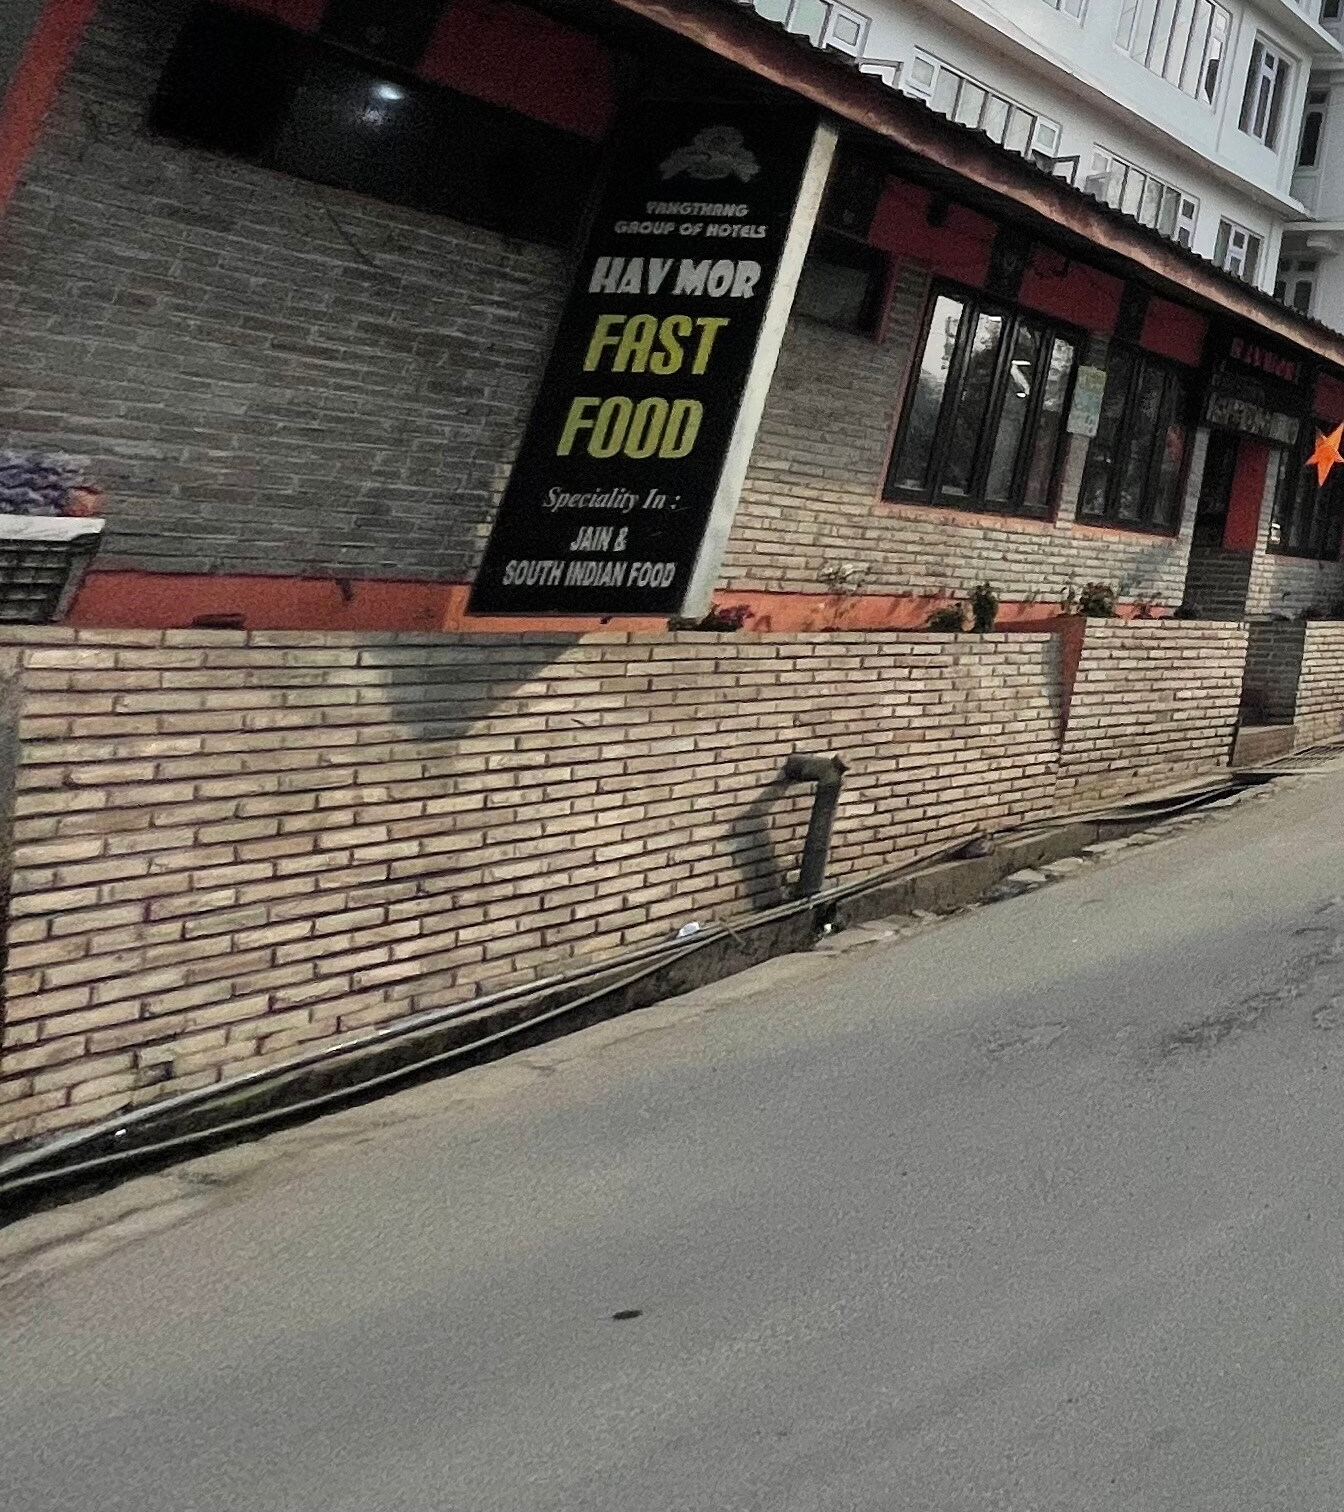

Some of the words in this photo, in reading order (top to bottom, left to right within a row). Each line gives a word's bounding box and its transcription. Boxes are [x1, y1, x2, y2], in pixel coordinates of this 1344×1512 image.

[614, 221, 676, 234] GROUP
[679, 223, 704, 236] OF
[706, 224, 766, 238] HOTELS
[583, 314, 731, 375] FAST
[557, 396, 704, 458] FOOD
[543, 487, 640, 513] Speciality
[570, 526, 614, 552] JAIN
[613, 526, 629, 552] &
[503, 560, 566, 586] SOUTH
[564, 561, 628, 587] INDIAN
[627, 562, 676, 588] FOOD
